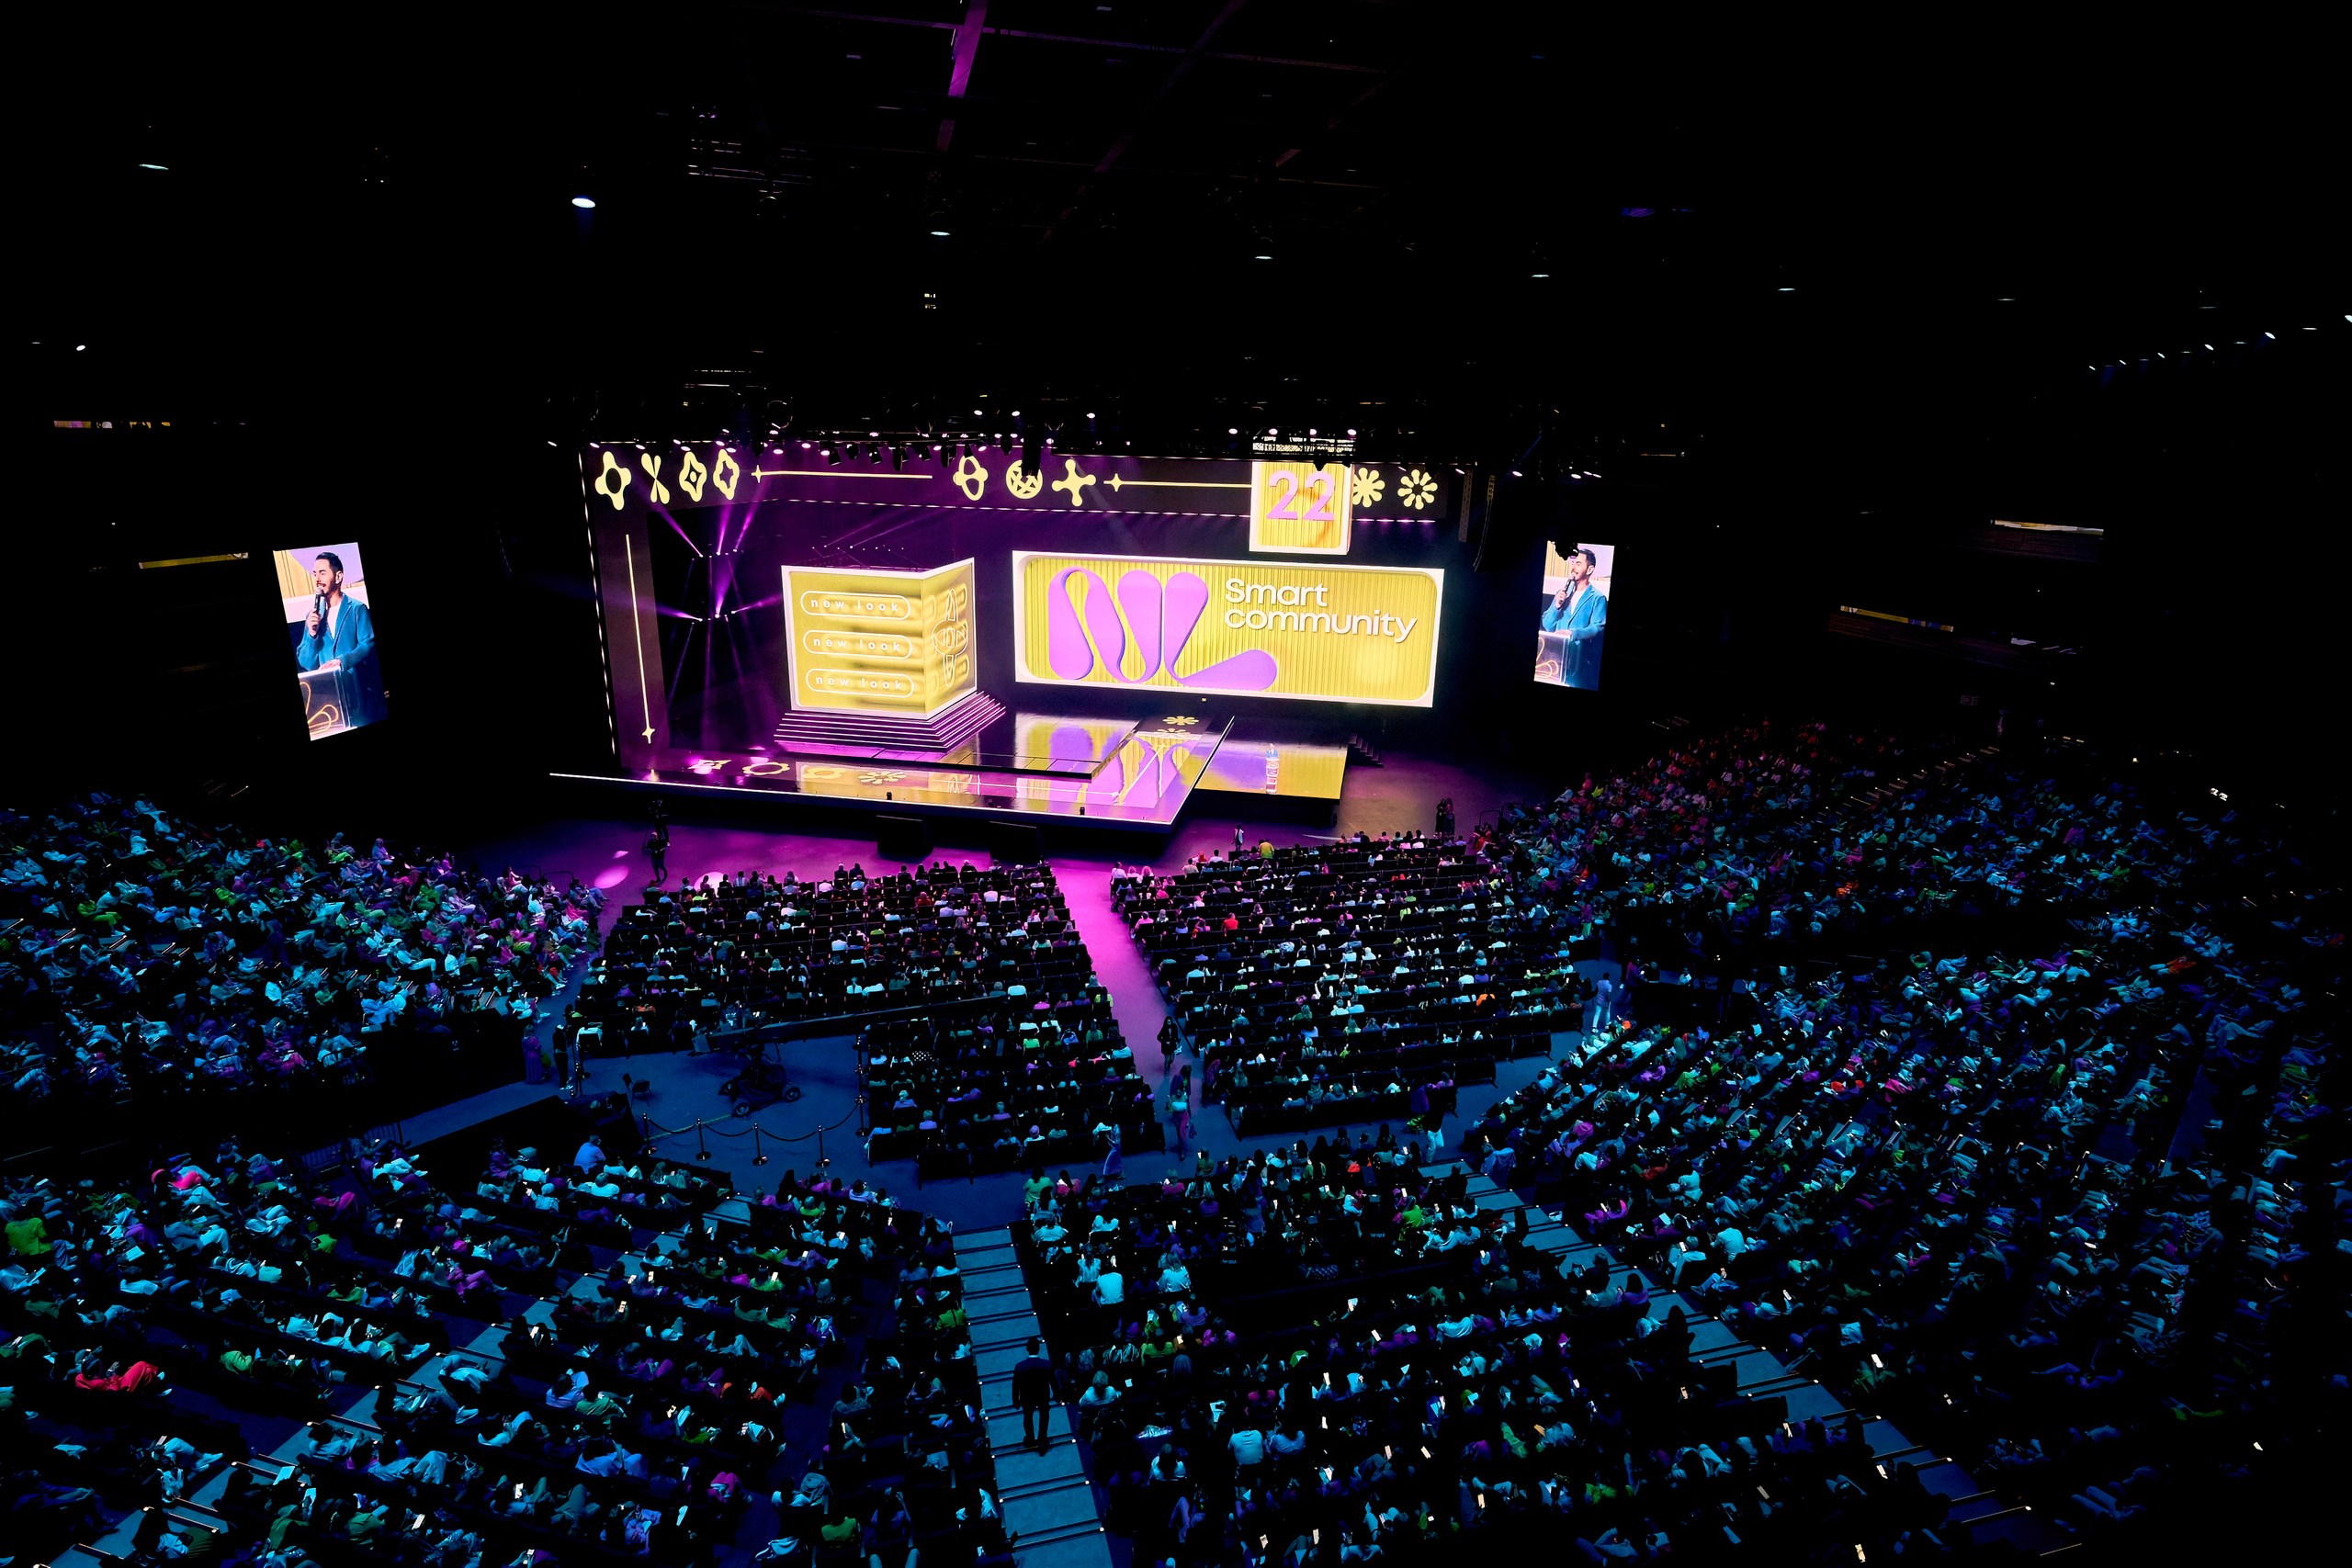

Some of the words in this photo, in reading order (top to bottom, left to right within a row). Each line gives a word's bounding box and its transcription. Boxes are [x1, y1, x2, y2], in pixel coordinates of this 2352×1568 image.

[1266, 469, 1336, 521] 22
[1225, 578, 1329, 608] Smart
[810, 599, 845, 610] new
[857, 601, 899, 613] look
[1224, 607, 1418, 643] community
[813, 637, 847, 648] new
[859, 639, 900, 651] look
[816, 675, 849, 686] new
[862, 678, 902, 690] look
